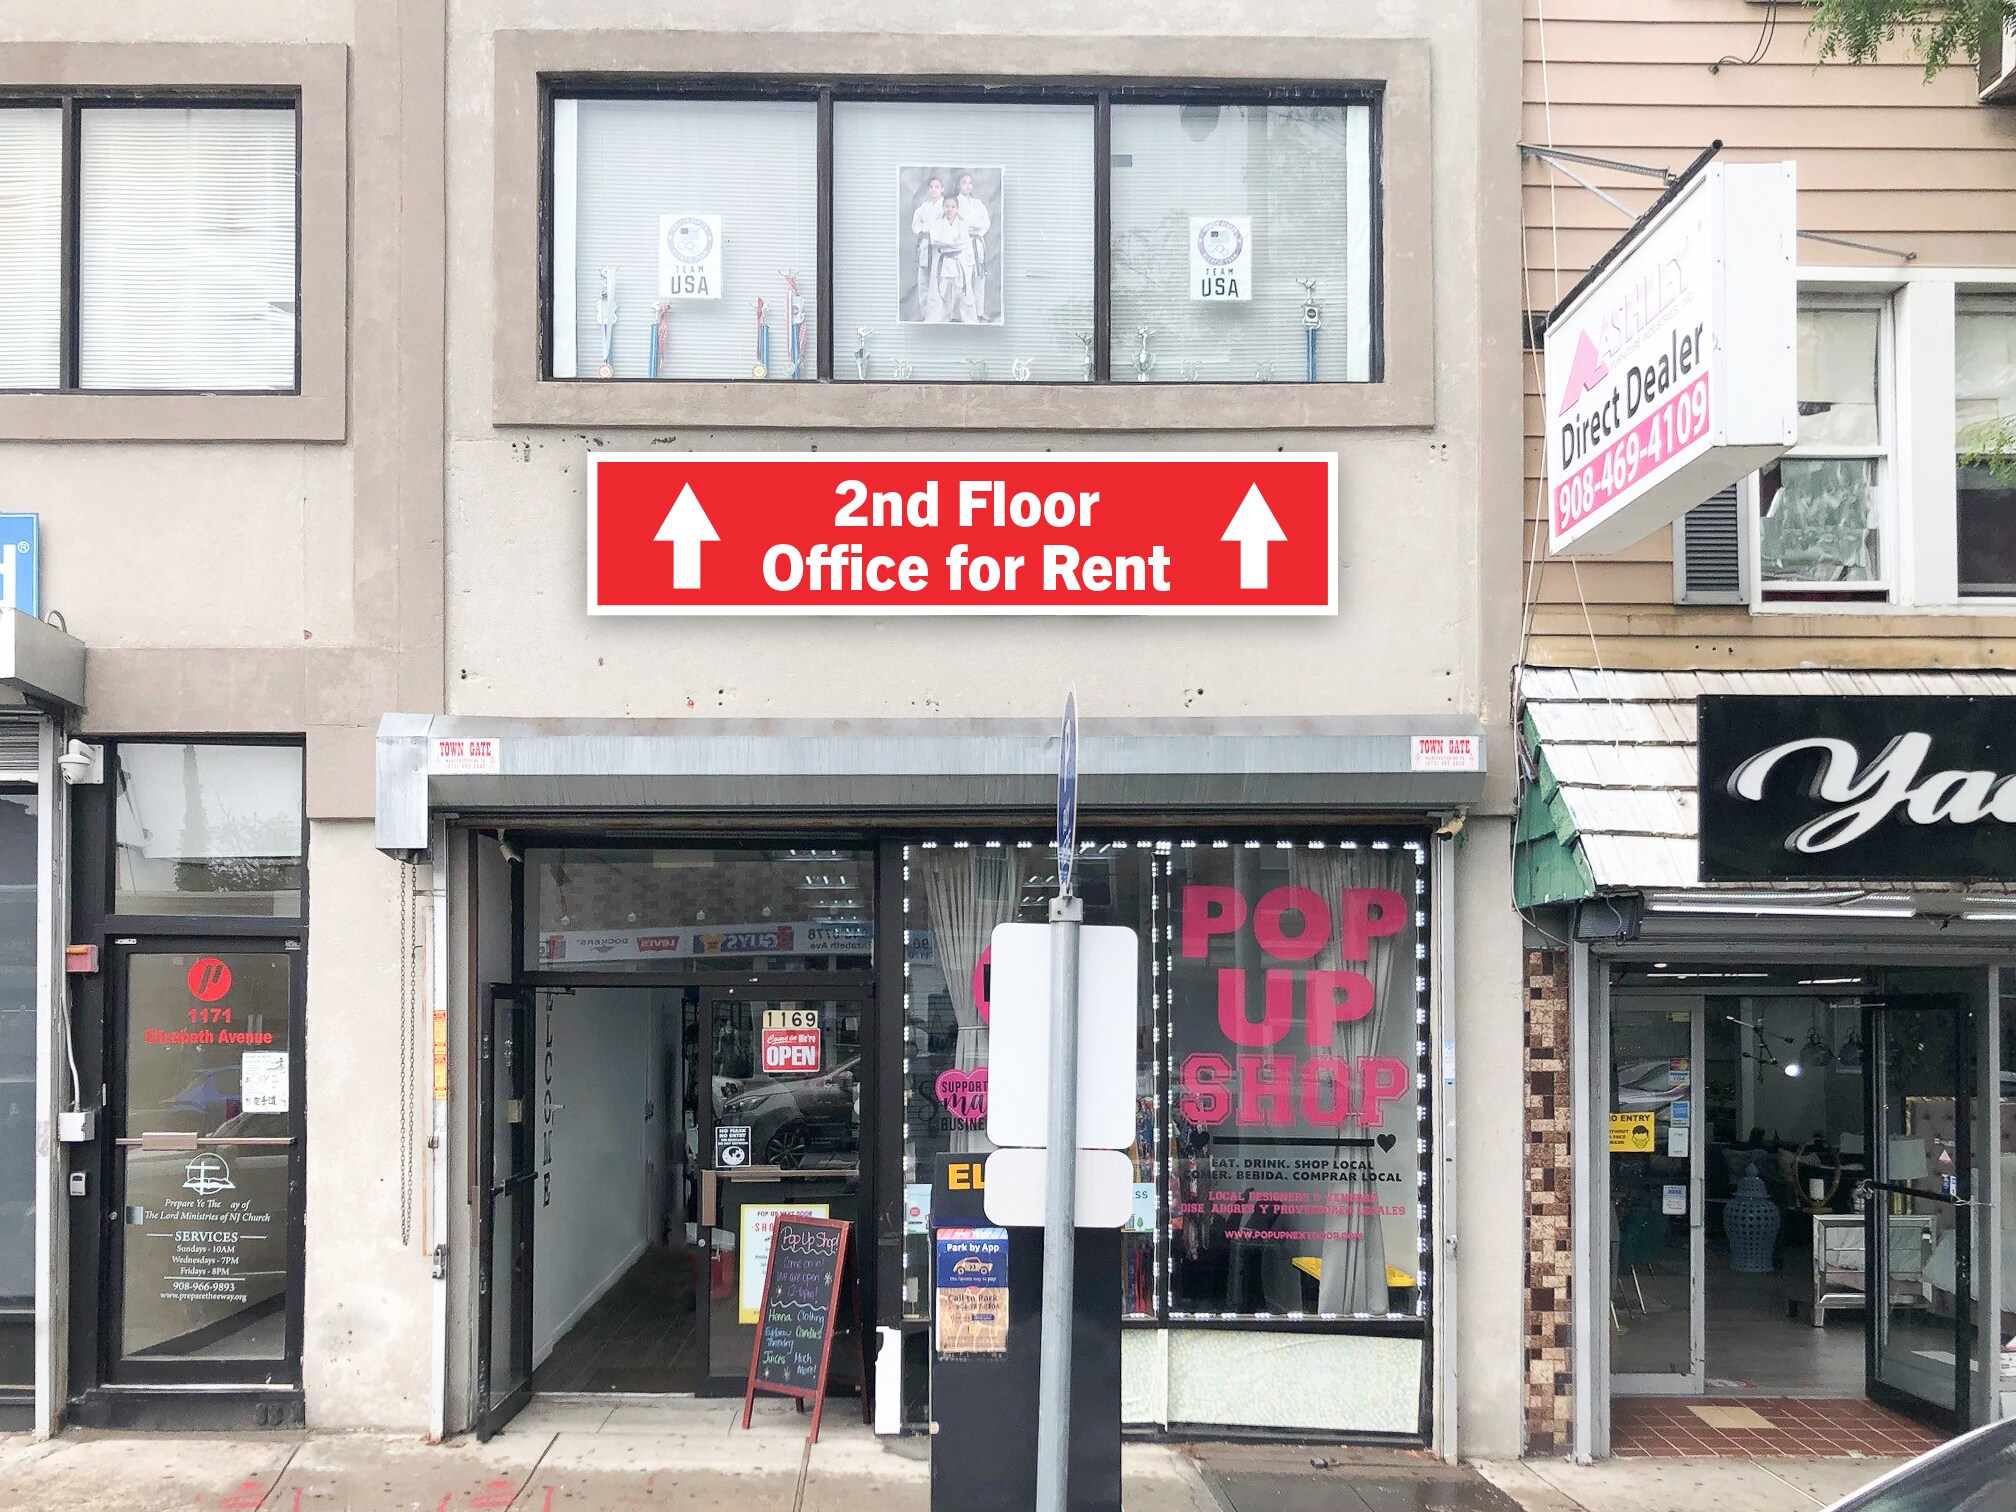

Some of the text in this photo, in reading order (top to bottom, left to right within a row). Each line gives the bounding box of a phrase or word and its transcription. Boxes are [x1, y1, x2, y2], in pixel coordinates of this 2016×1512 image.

[676, 265, 704, 273] TEAM
[1206, 268, 1233, 276] TEAM
[671, 275, 709, 295] USA
[1201, 277, 1239, 298] USA
[1561, 321, 1703, 471] Direct Dealer
[1558, 379, 1708, 530] 908-469-4109
[834, 479, 1101, 528] 2nd Floor
[762, 543, 1171, 592] Office for Rent
[439, 741, 492, 757] TOWN GATE
[1419, 739, 1471, 754] TOWN GATE
[1182, 884, 1409, 962] POP
[1217, 967, 1375, 1047] UP
[188, 1008, 232, 1024] 1171
[767, 1011, 816, 1027] 1169
[144, 1028, 273, 1044] Elizabeth Avenue
[766, 1045, 816, 1066] OPEN
[941, 1080, 988, 1093] SUPPORT
[1179, 1052, 1410, 1128] SHOP
[941, 1117, 985, 1131] BUSINE
[1620, 1114, 1651, 1122] ENTRY
[1211, 1158, 1374, 1170] EAT. DRINK. SHOP LOCAL
[1236, 1170, 1288, 1181] BEBIDA.
[1293, 1170, 1357, 1182] COMPRAR
[1361, 1172, 1402, 1182] LOCAL
[1208, 1190, 1244, 1201] LOCAL
[1248, 1191, 1309, 1202] DESIGNERS
[164, 1199, 195, 1209] Prepare
[196, 1199, 206, 1208] Ye
[207, 1199, 221, 1208] The
[241, 1199, 251, 1211] of
[1259, 1203, 1269, 1214] Y
[1357, 1205, 1406, 1216] LOCALES
[145, 1210, 270, 1223] The Lord Ministries of NJ Church
[174, 1231, 239, 1243] SERVICES
[781, 1225, 840, 1252] Pop Up Shop!
[176, 1245, 207, 1254] Sundays
[213, 1246, 235, 1254] 10AM
[946, 1243, 1000, 1253] Park by App
[172, 1256, 216, 1266] Wednesdays
[221, 1256, 239, 1265] 7PM
[180, 1267, 207, 1276] Fridays
[212, 1267, 230, 1276] 8PM
[172, 1281, 235, 1292] 908-966-9893
[978, 1294, 998, 1302] Park
[768, 1308, 792, 1323] Henna
[797, 1310, 825, 1332] Clothing
[795, 1325, 822, 1340] Candles
[762, 1350, 786, 1365] Juices
